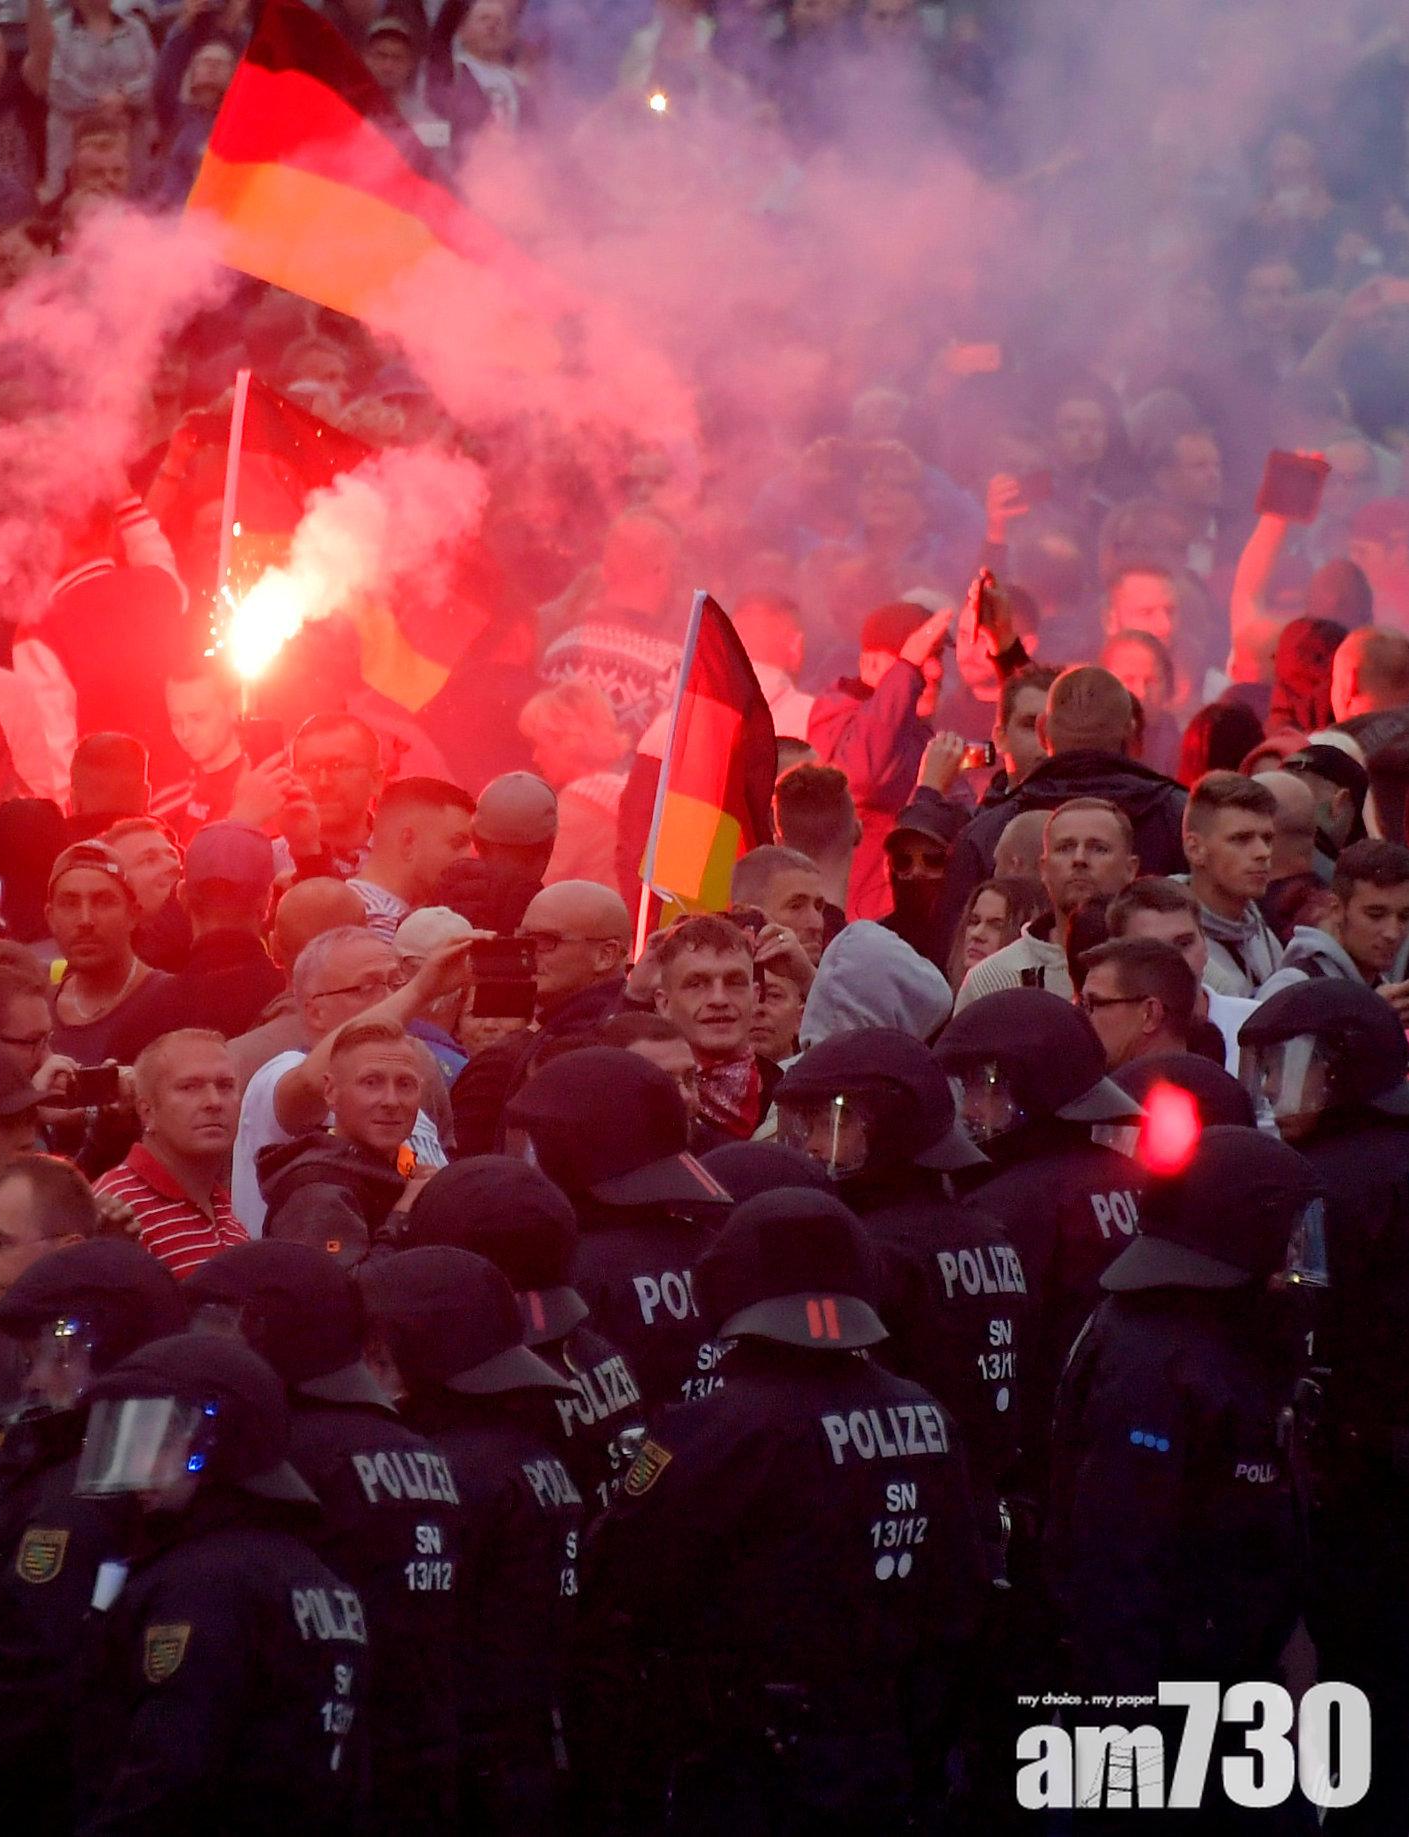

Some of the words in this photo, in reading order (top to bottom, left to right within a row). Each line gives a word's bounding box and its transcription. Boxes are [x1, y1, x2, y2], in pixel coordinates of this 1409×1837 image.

[988, 1318, 1013, 1347] SN
[977, 1352, 1018, 1381] 13/1
[821, 1405, 950, 1465] POLIZEI
[886, 1482, 917, 1513] SN
[415, 1525, 442, 1555] SN
[871, 1517, 928, 1549] 13/12
[403, 1561, 453, 1592] 13/12
